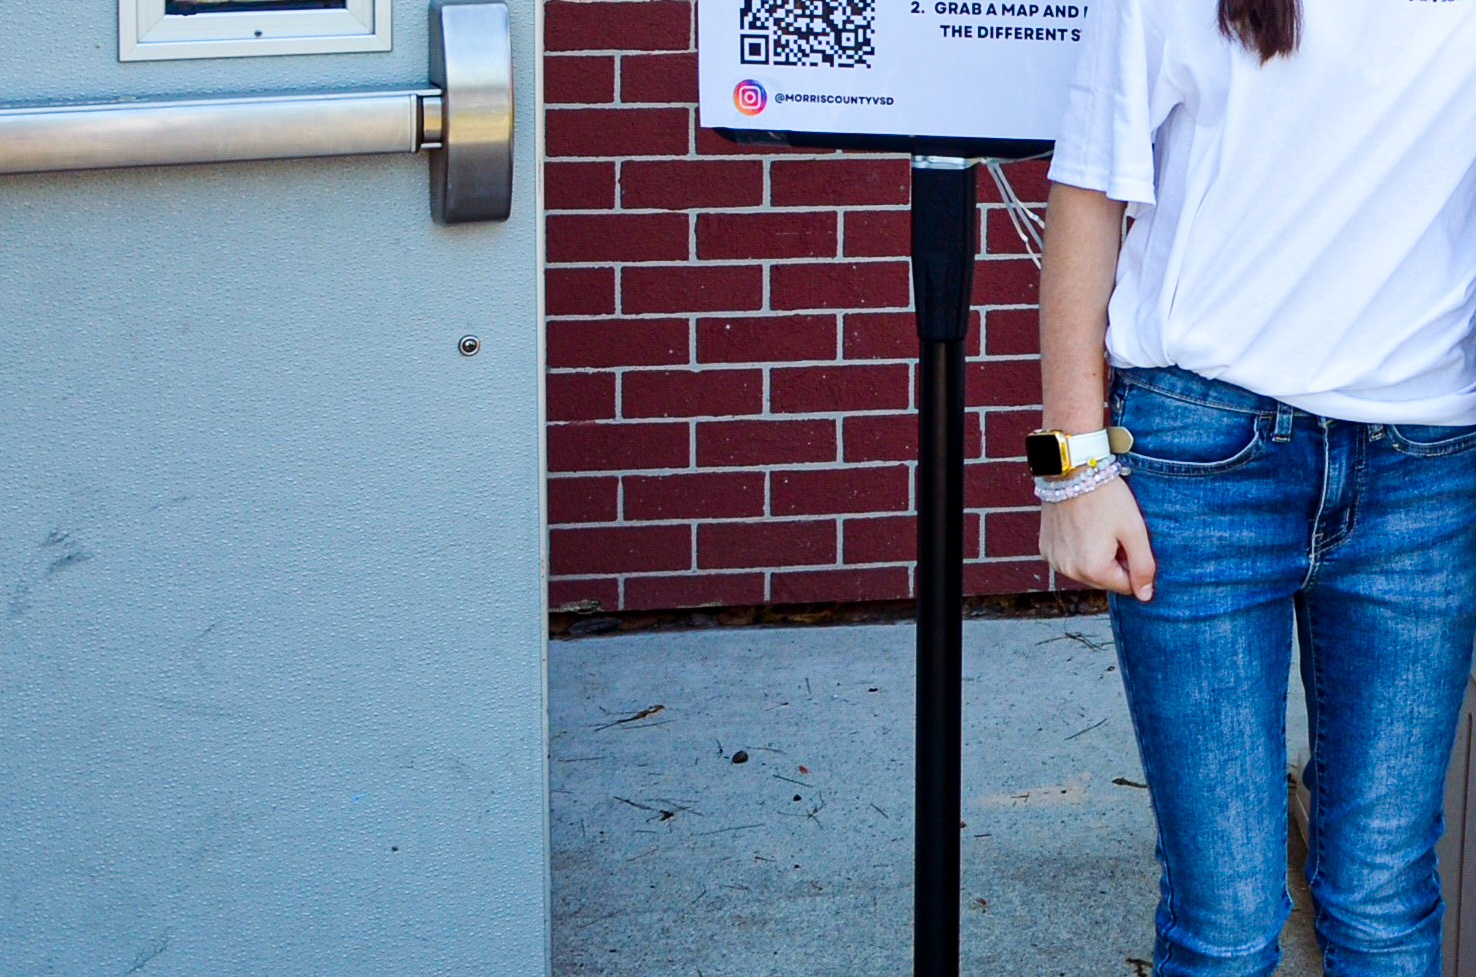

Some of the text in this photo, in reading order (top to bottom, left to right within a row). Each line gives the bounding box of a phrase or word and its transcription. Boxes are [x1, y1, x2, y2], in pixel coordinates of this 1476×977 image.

[910, 0, 925, 14] 2.
[934, 1, 982, 16] GRAB
[985, 2, 998, 16] A
[1001, 3, 1040, 18] MAP
[1042, 4, 1080, 19] AND
[939, 24, 1083, 42] THE DIFFERENT S
[774, 92, 895, 106] @MORRISCOUNTYVSD
